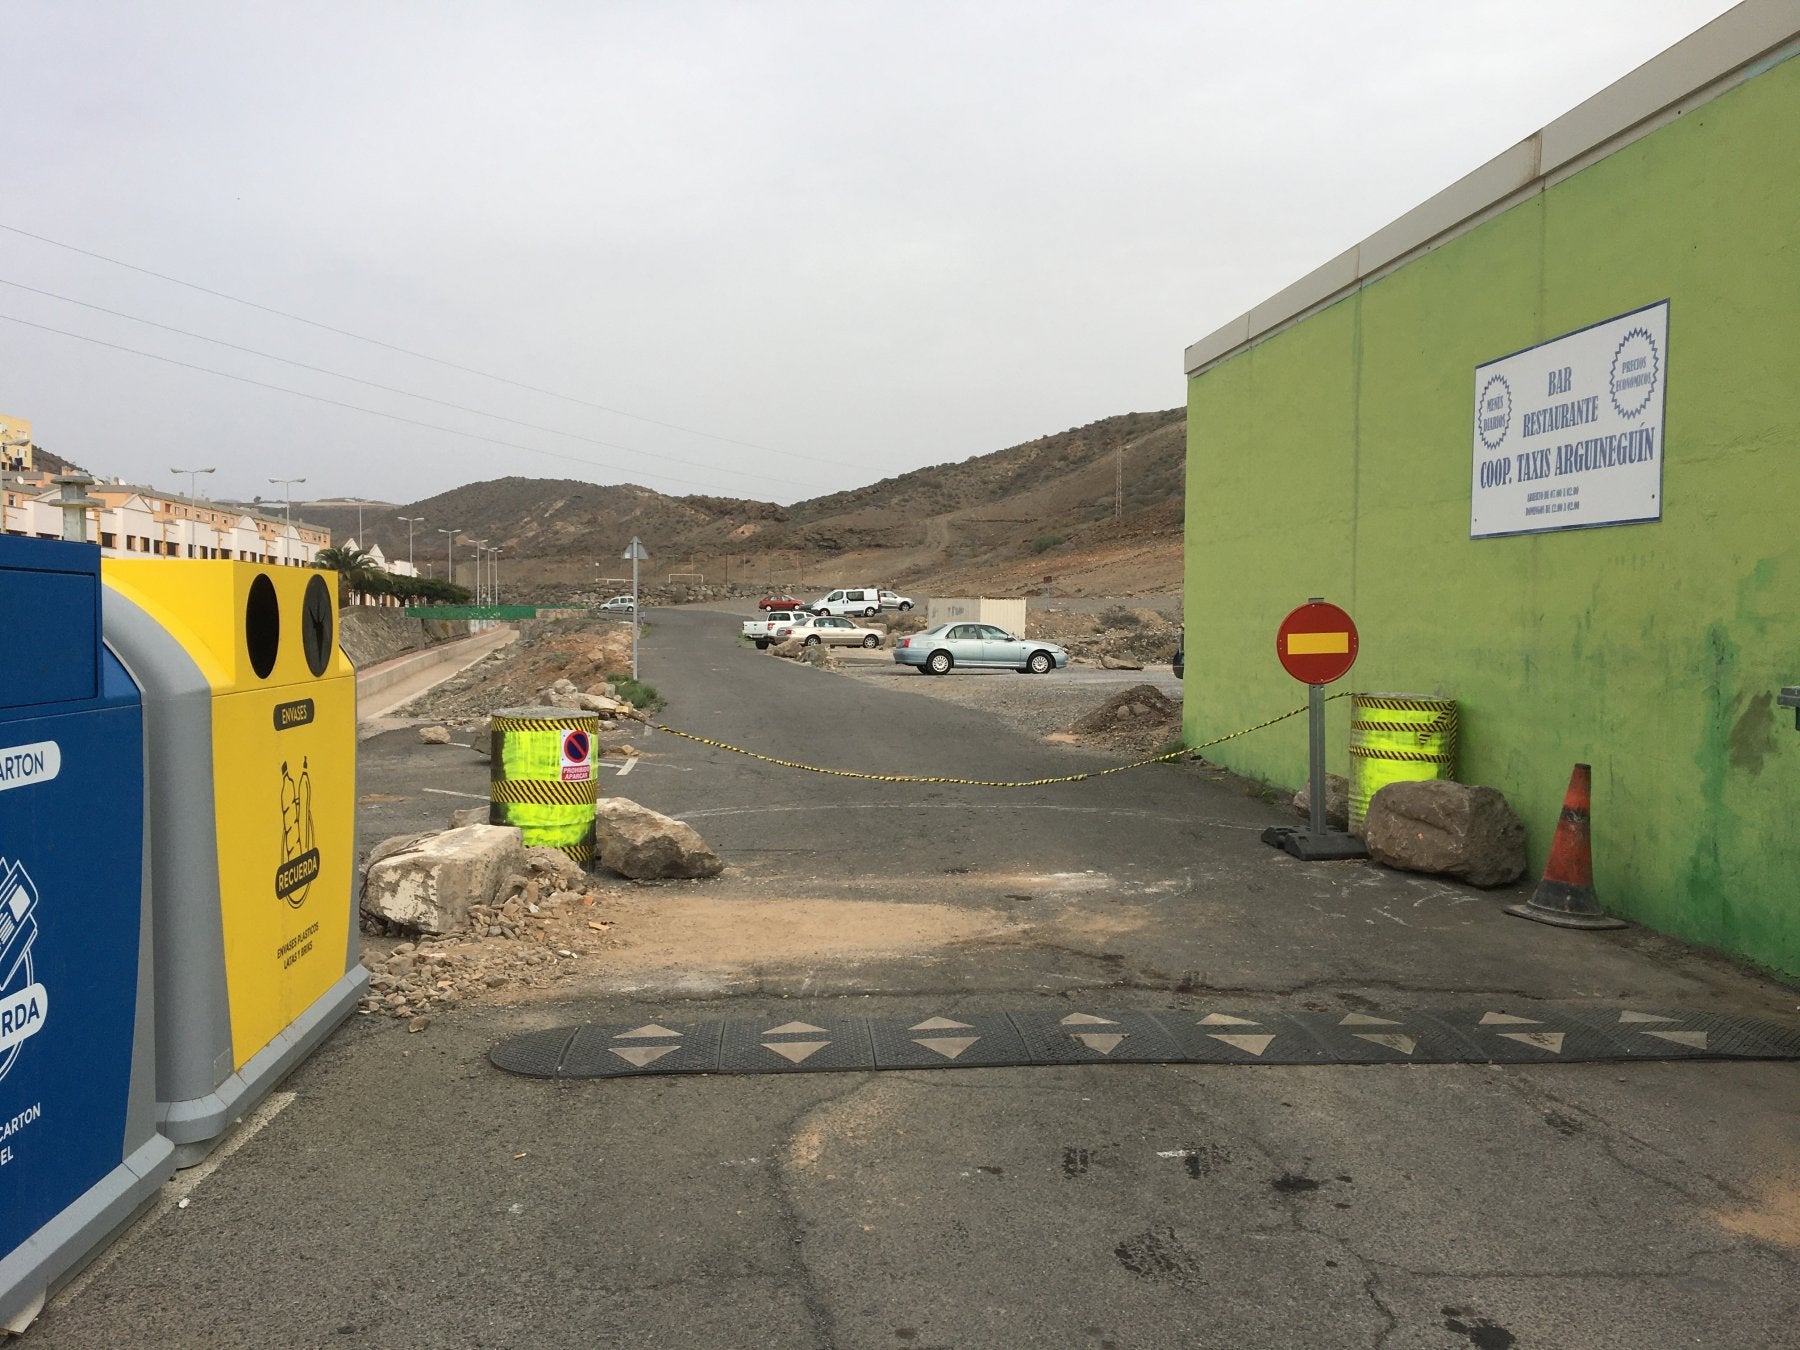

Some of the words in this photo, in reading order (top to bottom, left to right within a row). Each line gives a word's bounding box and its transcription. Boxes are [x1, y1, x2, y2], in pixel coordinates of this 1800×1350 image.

[1622, 356, 1646, 374] PRECIOS
[1548, 366, 1572, 396] BAR
[1483, 413, 1505, 432] DIARIOS
[1523, 395, 1599, 438] RESTAURANTE
[1480, 457, 1512, 489] COOP.
[1517, 448, 1551, 482] TAXIS
[1554, 421, 1655, 476] ARGUINEGUÍN
[281, 704, 307, 725] ENVASES
[278, 855, 318, 892] RECUERDA
[277, 936, 297, 960] ENVASES
[297, 921, 319, 945] PLASTICOS
[283, 952, 297, 970] LATAS
[301, 940, 313, 957] BRIKS
